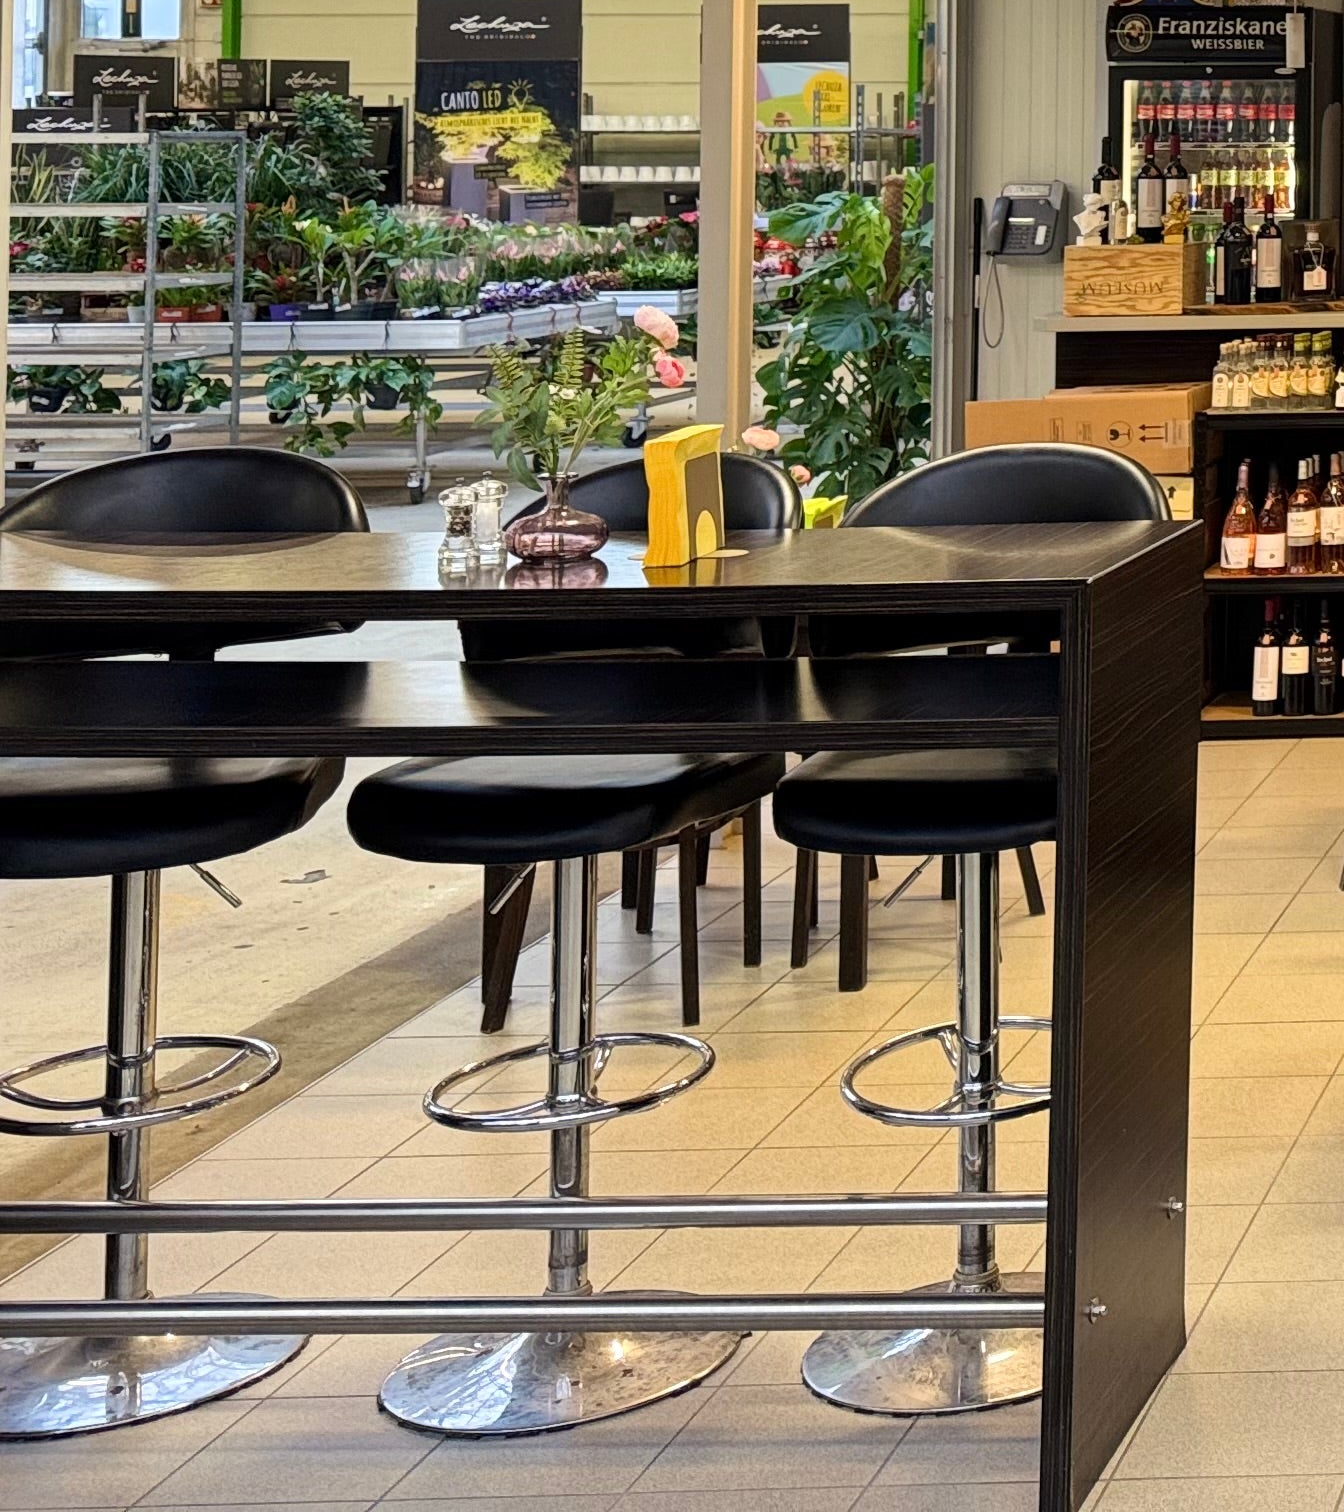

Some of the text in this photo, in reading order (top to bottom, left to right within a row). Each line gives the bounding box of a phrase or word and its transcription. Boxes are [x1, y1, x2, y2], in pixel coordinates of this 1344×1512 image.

[1157, 16, 1288, 36] Franziskane
[1190, 38, 1266, 51] WEISSBIER
[440, 89, 502, 111] CANTO LED
